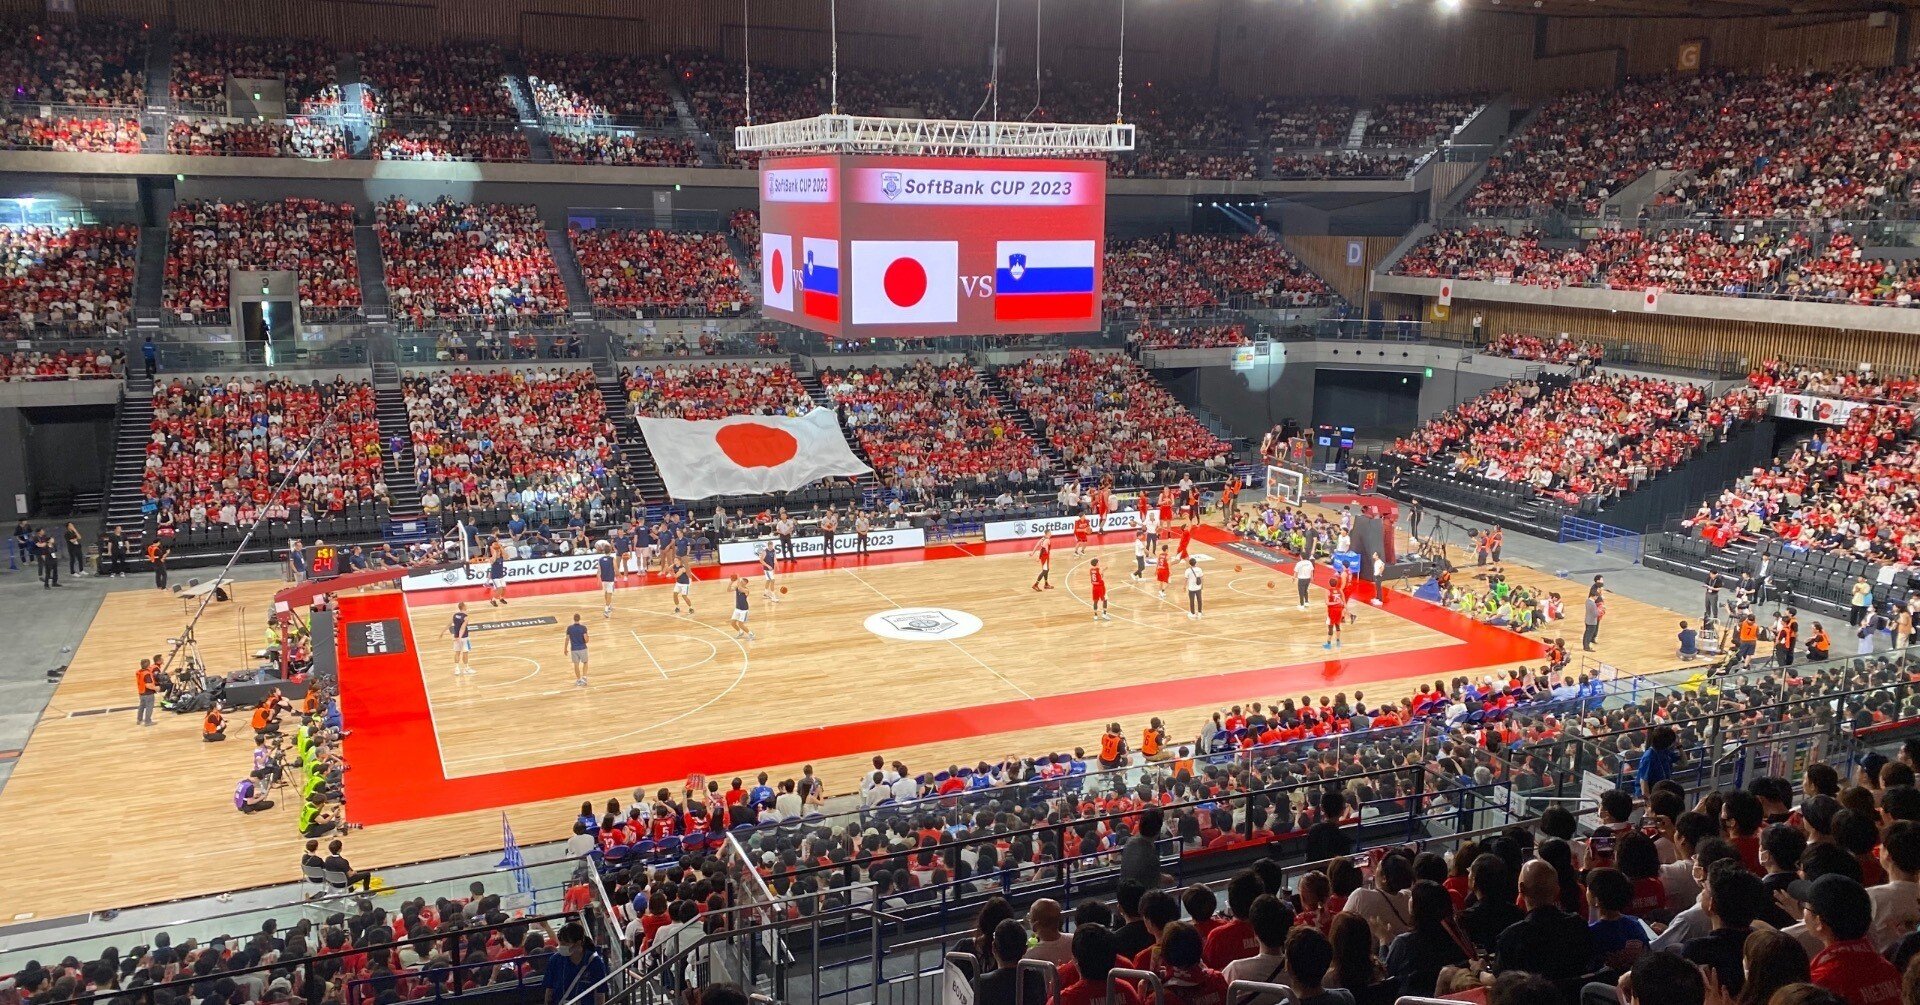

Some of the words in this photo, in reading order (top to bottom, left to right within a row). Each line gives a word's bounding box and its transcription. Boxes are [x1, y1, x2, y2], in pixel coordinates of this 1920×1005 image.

[774, 179, 798, 193] SoftBank
[799, 178, 812, 192] CUP
[812, 178, 828, 192] 2023
[905, 179, 984, 195] SoftBank
[990, 181, 1025, 195] CUP
[1030, 181, 1072, 196] 2023
[1348, 243, 1361, 263] D
[262, 277, 270, 288] 9
[1031, 520, 1074, 533] SoftBan
[865, 535, 894, 547] 2023
[314, 559, 332, 572] 24
[538, 560, 570, 574] CUP
[482, 619, 546, 630] SoftBank
